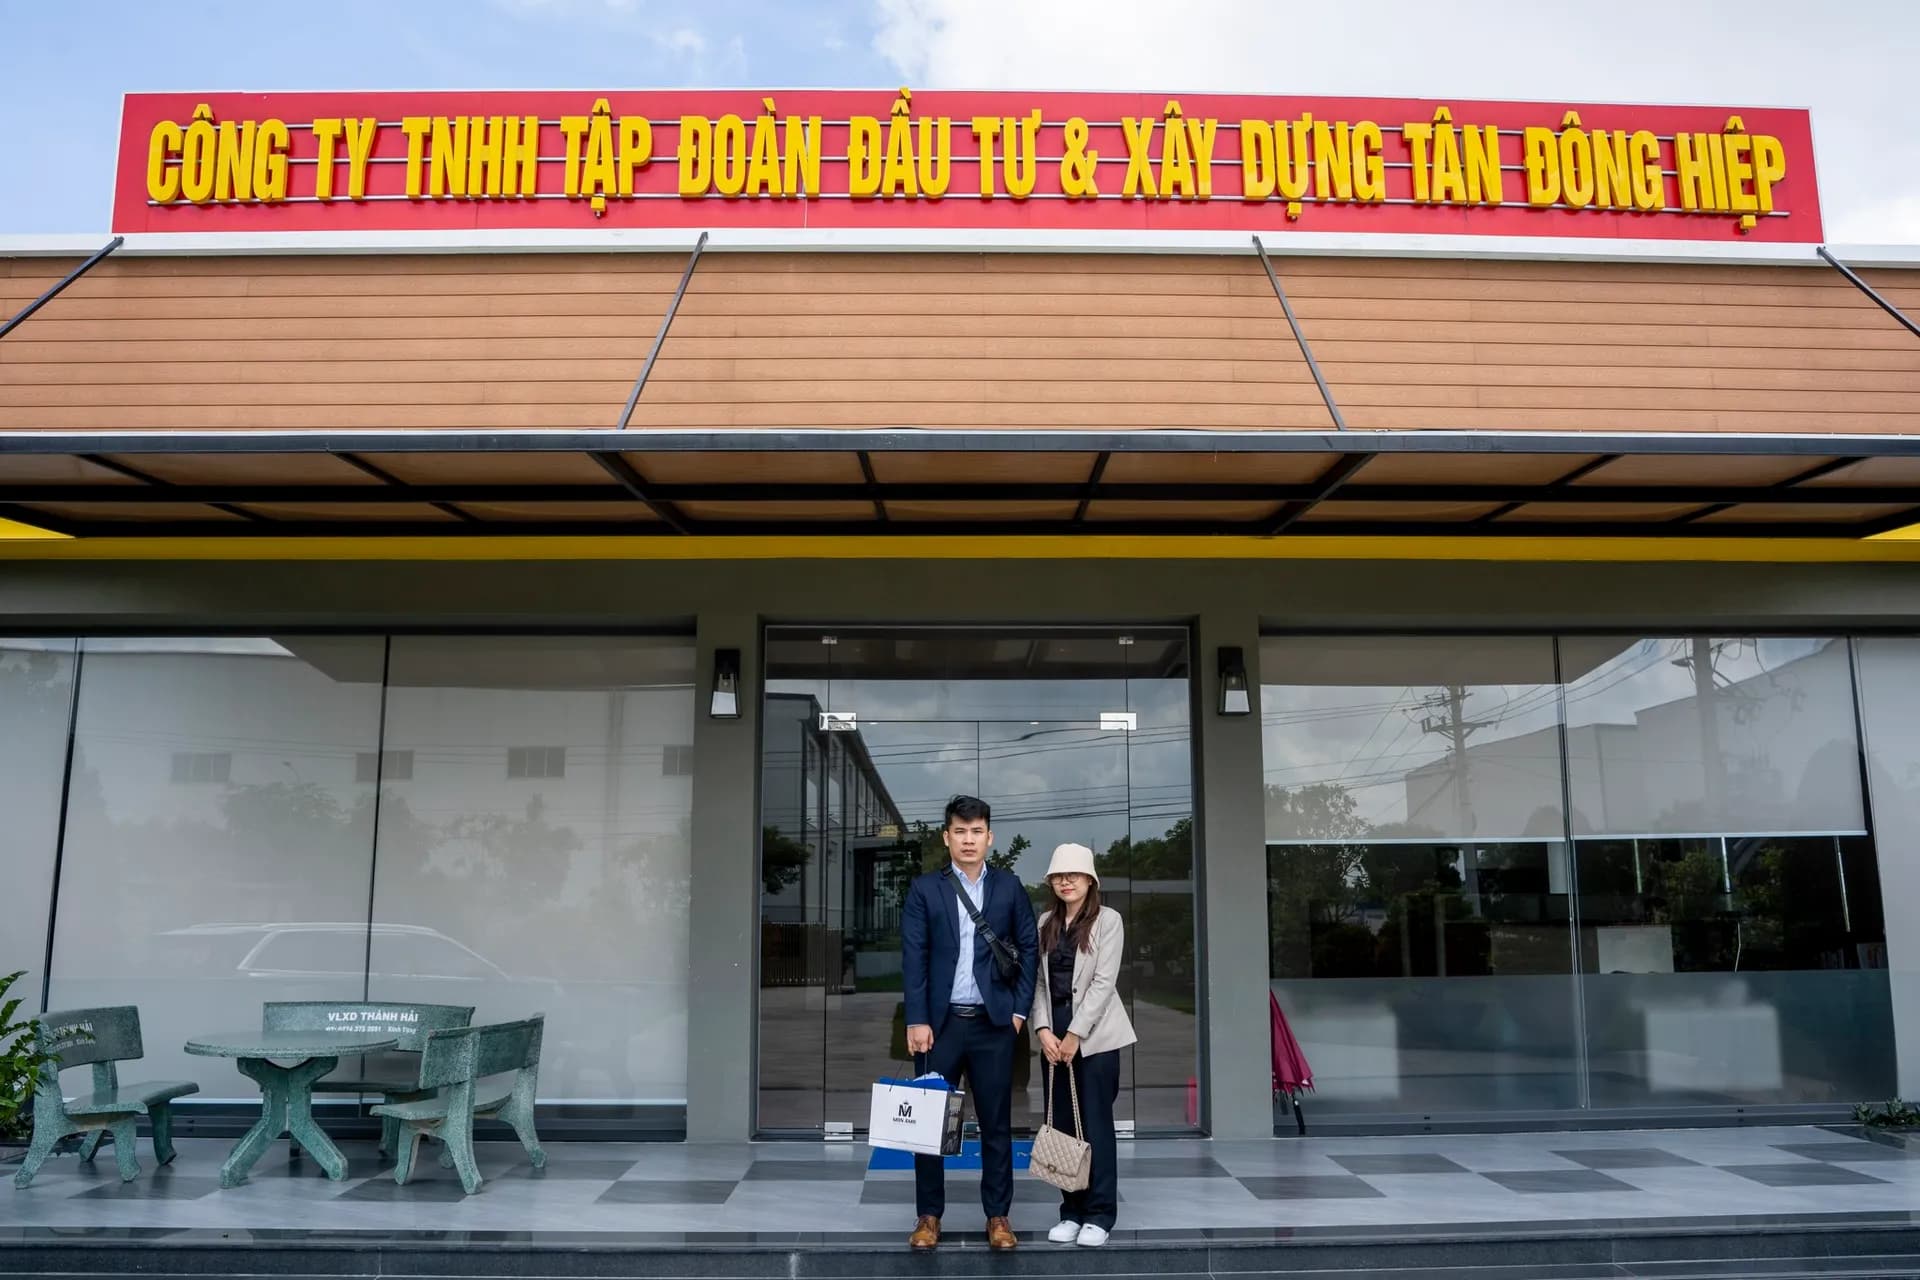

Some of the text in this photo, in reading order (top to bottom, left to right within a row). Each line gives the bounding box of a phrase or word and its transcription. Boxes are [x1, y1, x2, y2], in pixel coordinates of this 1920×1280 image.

[147, 86, 1786, 233] CÔNG TY TNHH TẬP ĐOÀN ĐẦU TƯ & XÂY DỰNG TÂN ĐÔNG HIỆP
[328, 1012, 357, 1022] VLXD
